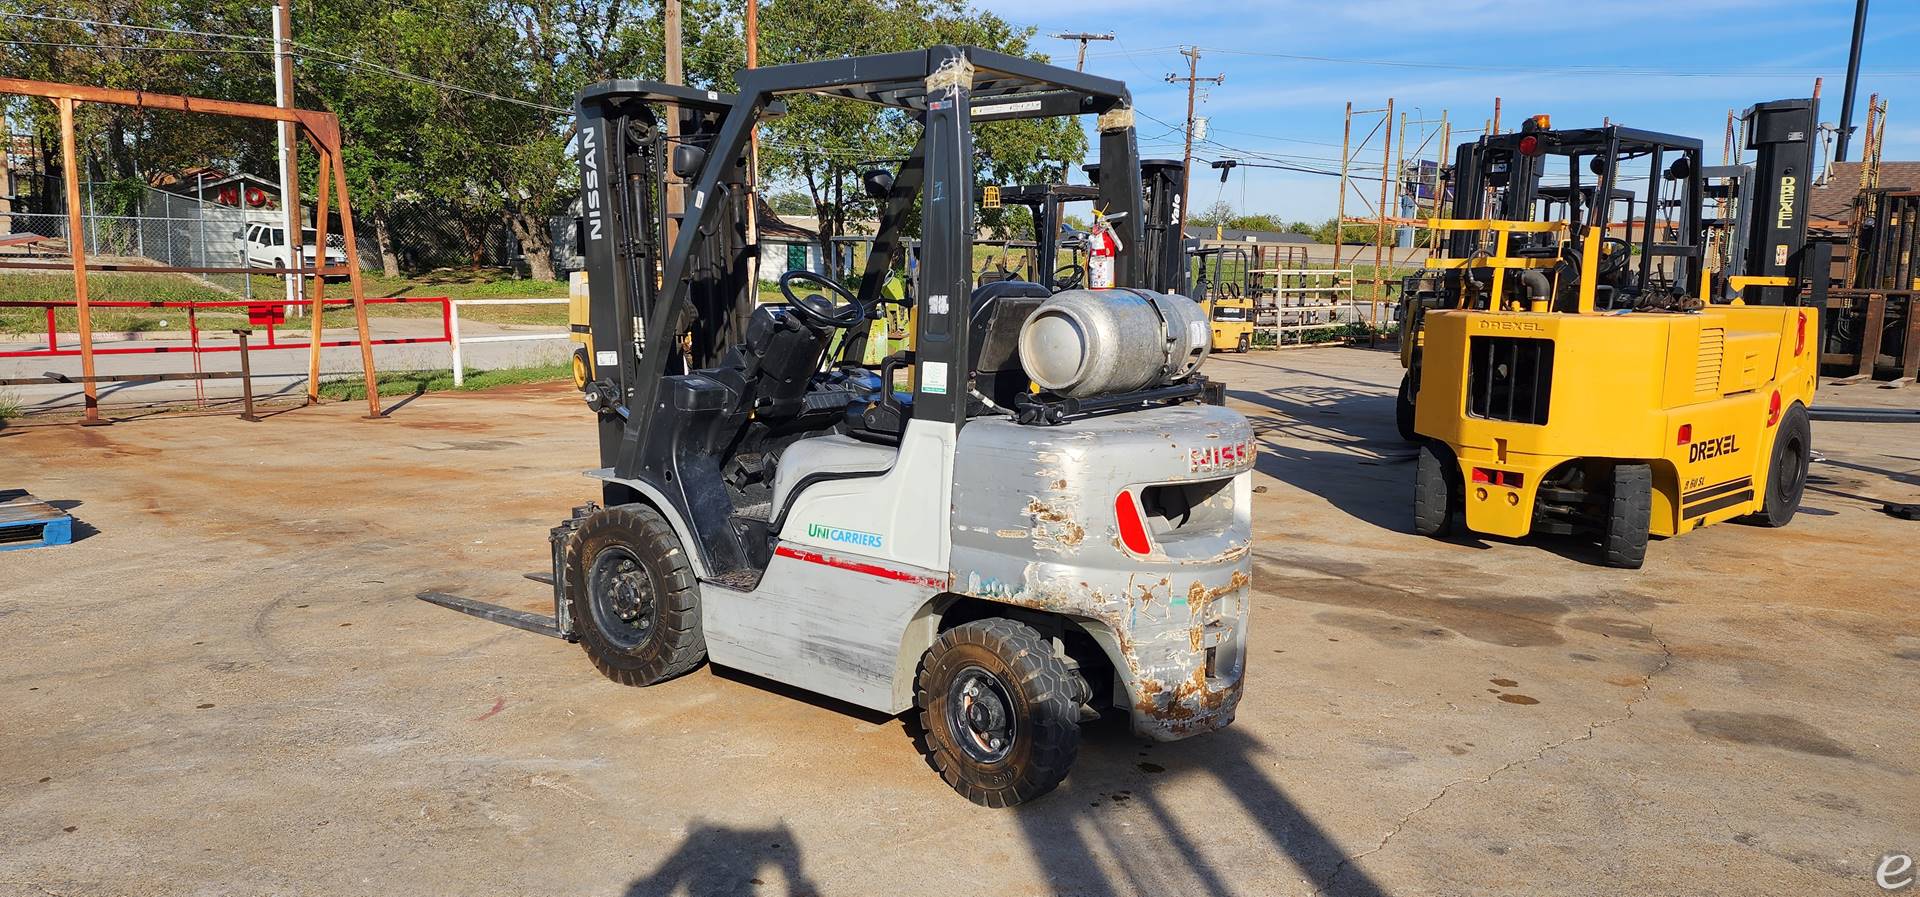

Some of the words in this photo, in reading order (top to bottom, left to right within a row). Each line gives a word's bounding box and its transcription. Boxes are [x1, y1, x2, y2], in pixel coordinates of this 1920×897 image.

[583, 126, 602, 240] NISSAN
[1171, 193, 1181, 225] Yale
[1777, 176, 1796, 229] DREXEL
[1479, 320, 1544, 332] DREXEL
[1689, 434, 1740, 463] DREXEL
